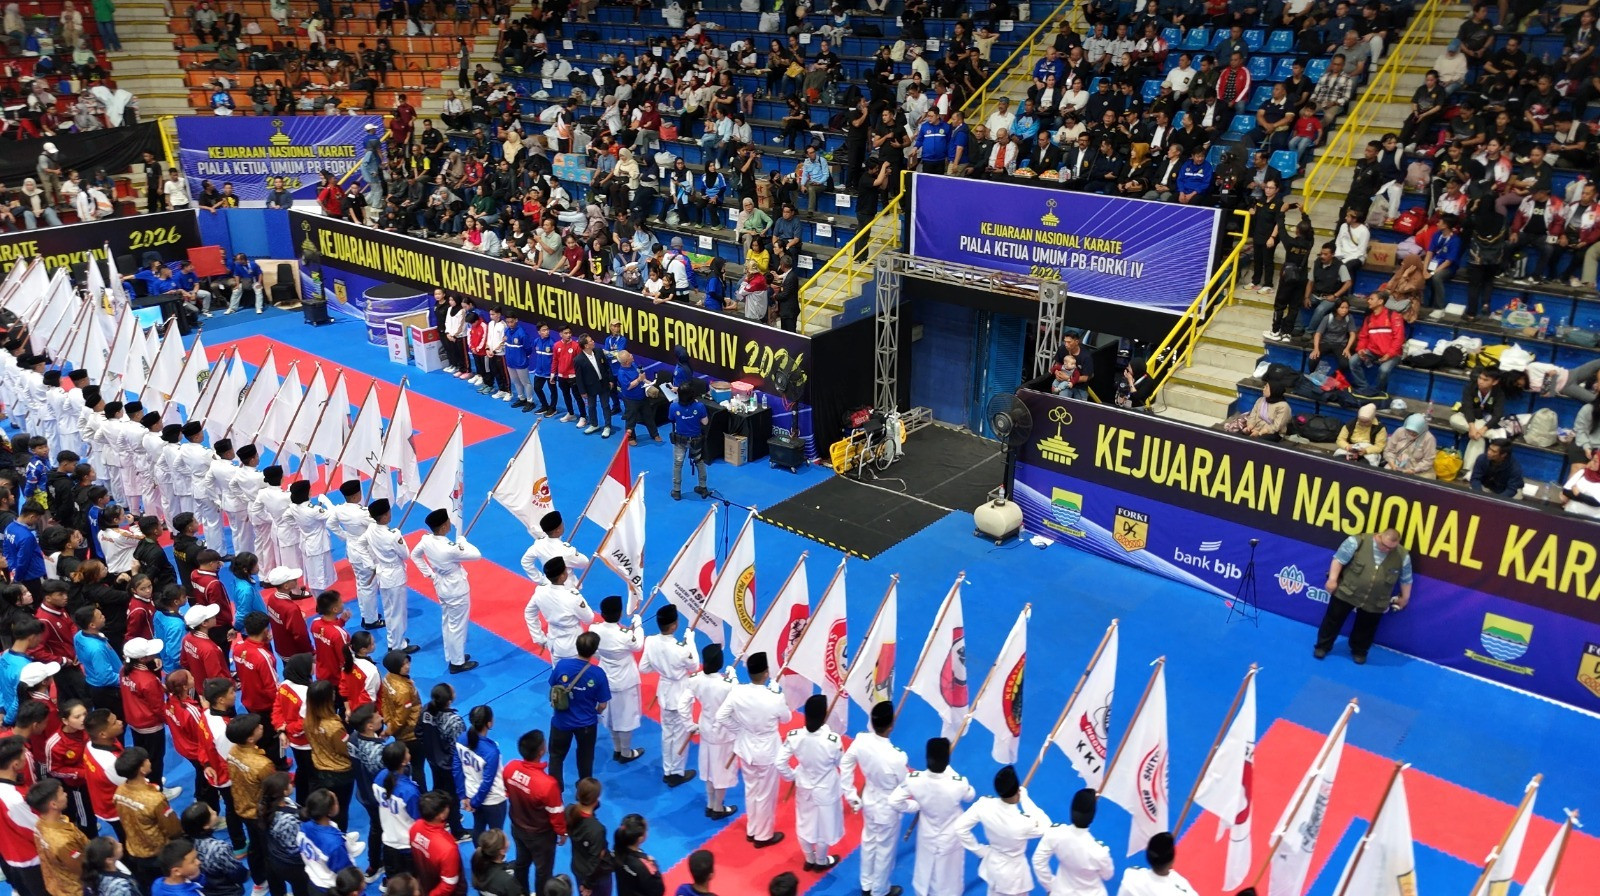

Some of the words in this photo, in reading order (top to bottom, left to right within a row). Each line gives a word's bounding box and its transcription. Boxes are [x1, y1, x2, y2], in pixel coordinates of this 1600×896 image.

[208, 146, 266, 159] KEJUARAAN
[269, 146, 315, 158] NASIONAL
[318, 145, 356, 158] KARATE
[197, 162, 230, 175] PIALA
[233, 162, 268, 175] KETUA
[270, 161, 304, 174] UMUM
[307, 161, 322, 174] PB
[265, 176, 302, 189] 226
[129, 225, 182, 250] 2026
[981, 221, 1034, 242] KEJUARAAN
[1035, 230, 1081, 249] NASIONAL
[1083, 236, 1123, 255] KARATE
[0, 241, 38, 261] RATE
[960, 235, 992, 256] PIALA
[994, 241, 1030, 261] KETUA
[1032, 246, 1068, 268] UMUM
[1070, 252, 1087, 270] PB
[1090, 257, 1127, 277] FORKI
[1130, 261, 1144, 279] IV
[1029, 264, 1062, 281] 2026
[317, 228, 382, 271] KEJUARAAN
[382, 244, 440, 287] NASIONAL
[441, 260, 492, 301] KARATE
[493, 273, 535, 313] PIALA
[536, 282, 584, 327] KETUA
[586, 295, 634, 341] UMUM
[637, 309, 660, 347] PB
[664, 316, 715, 364] FORKI
[720, 332, 738, 370] IV
[1094, 423, 1285, 515] KEJUARAAN
[1292, 472, 1483, 571] NASIONAL
[1497, 524, 1600, 602] KAR
[1117, 507, 1148, 522] FORKI
[1174, 547, 1210, 571] bank
[1214, 559, 1242, 581] bjb
[1306, 586, 1331, 605] an
